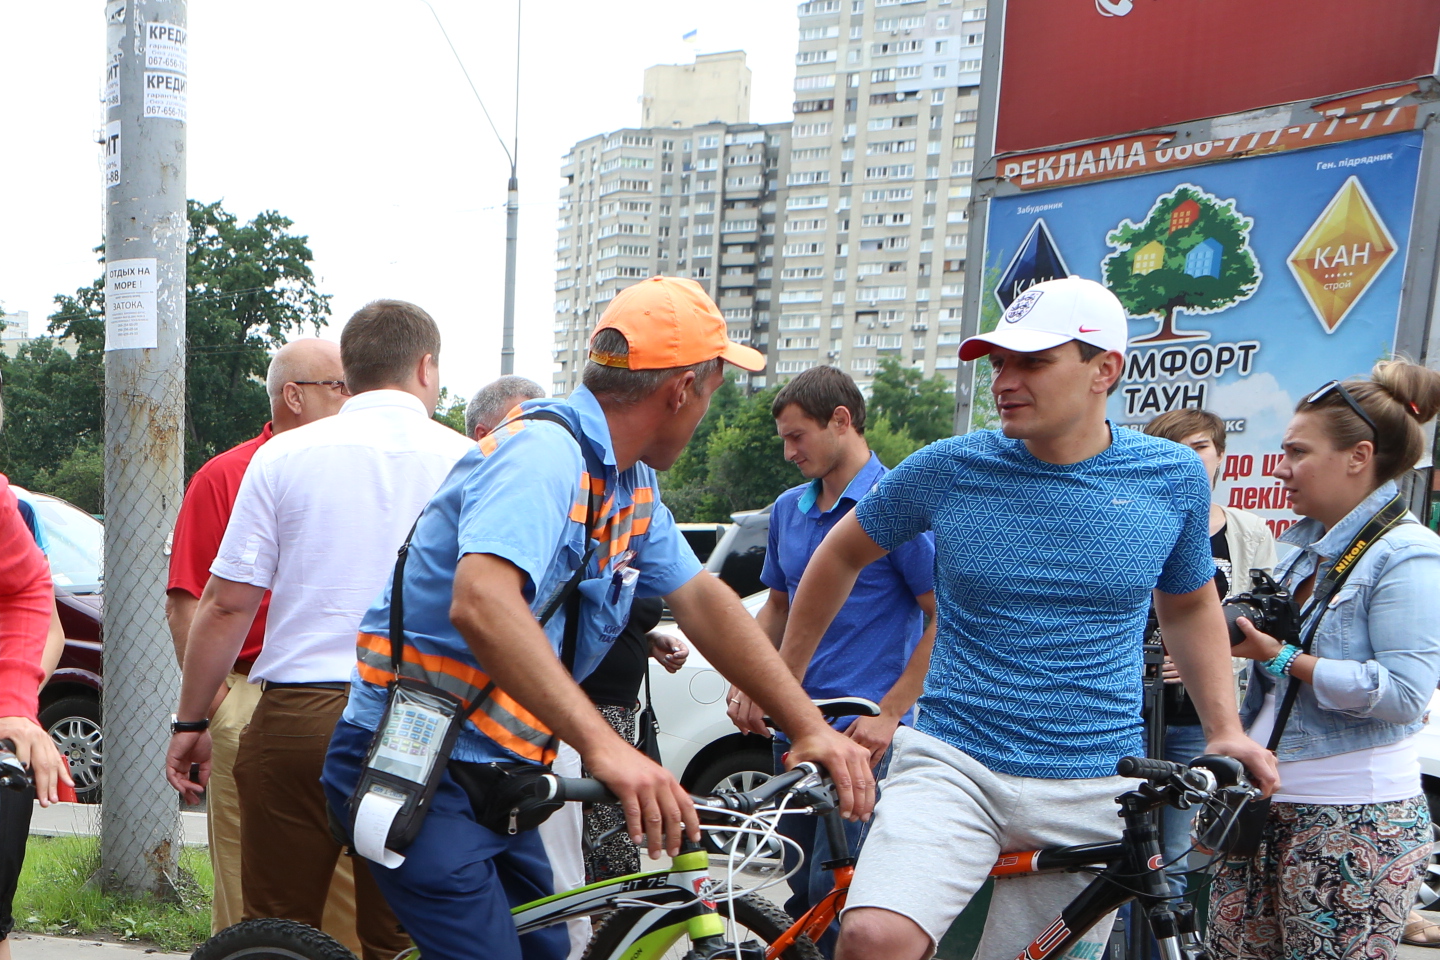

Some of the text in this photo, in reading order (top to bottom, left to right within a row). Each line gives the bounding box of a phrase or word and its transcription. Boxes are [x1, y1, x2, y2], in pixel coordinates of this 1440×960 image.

[1004, 141, 1146, 185] РЕКЛАМА
[1316, 152, 1393, 170] Ген. підрядник
[1017, 202, 1063, 215] Забудовник
[1313, 242, 1370, 269] КАН
[110, 267, 150, 278] ОТДЫХ НА
[114, 281, 137, 291] МОРЕ
[1323, 277, 1352, 291] строй
[113, 301, 145, 311] ЗАТОКА,
[1122, 345, 1257, 380] МФОРТ
[1125, 384, 1204, 414] ТАУН
[1222, 455, 1253, 481] до
[1334, 540, 1367, 574] Nikon
[619, 876, 667, 892] HT 75
[1067, 940, 1104, 960] NIKE
